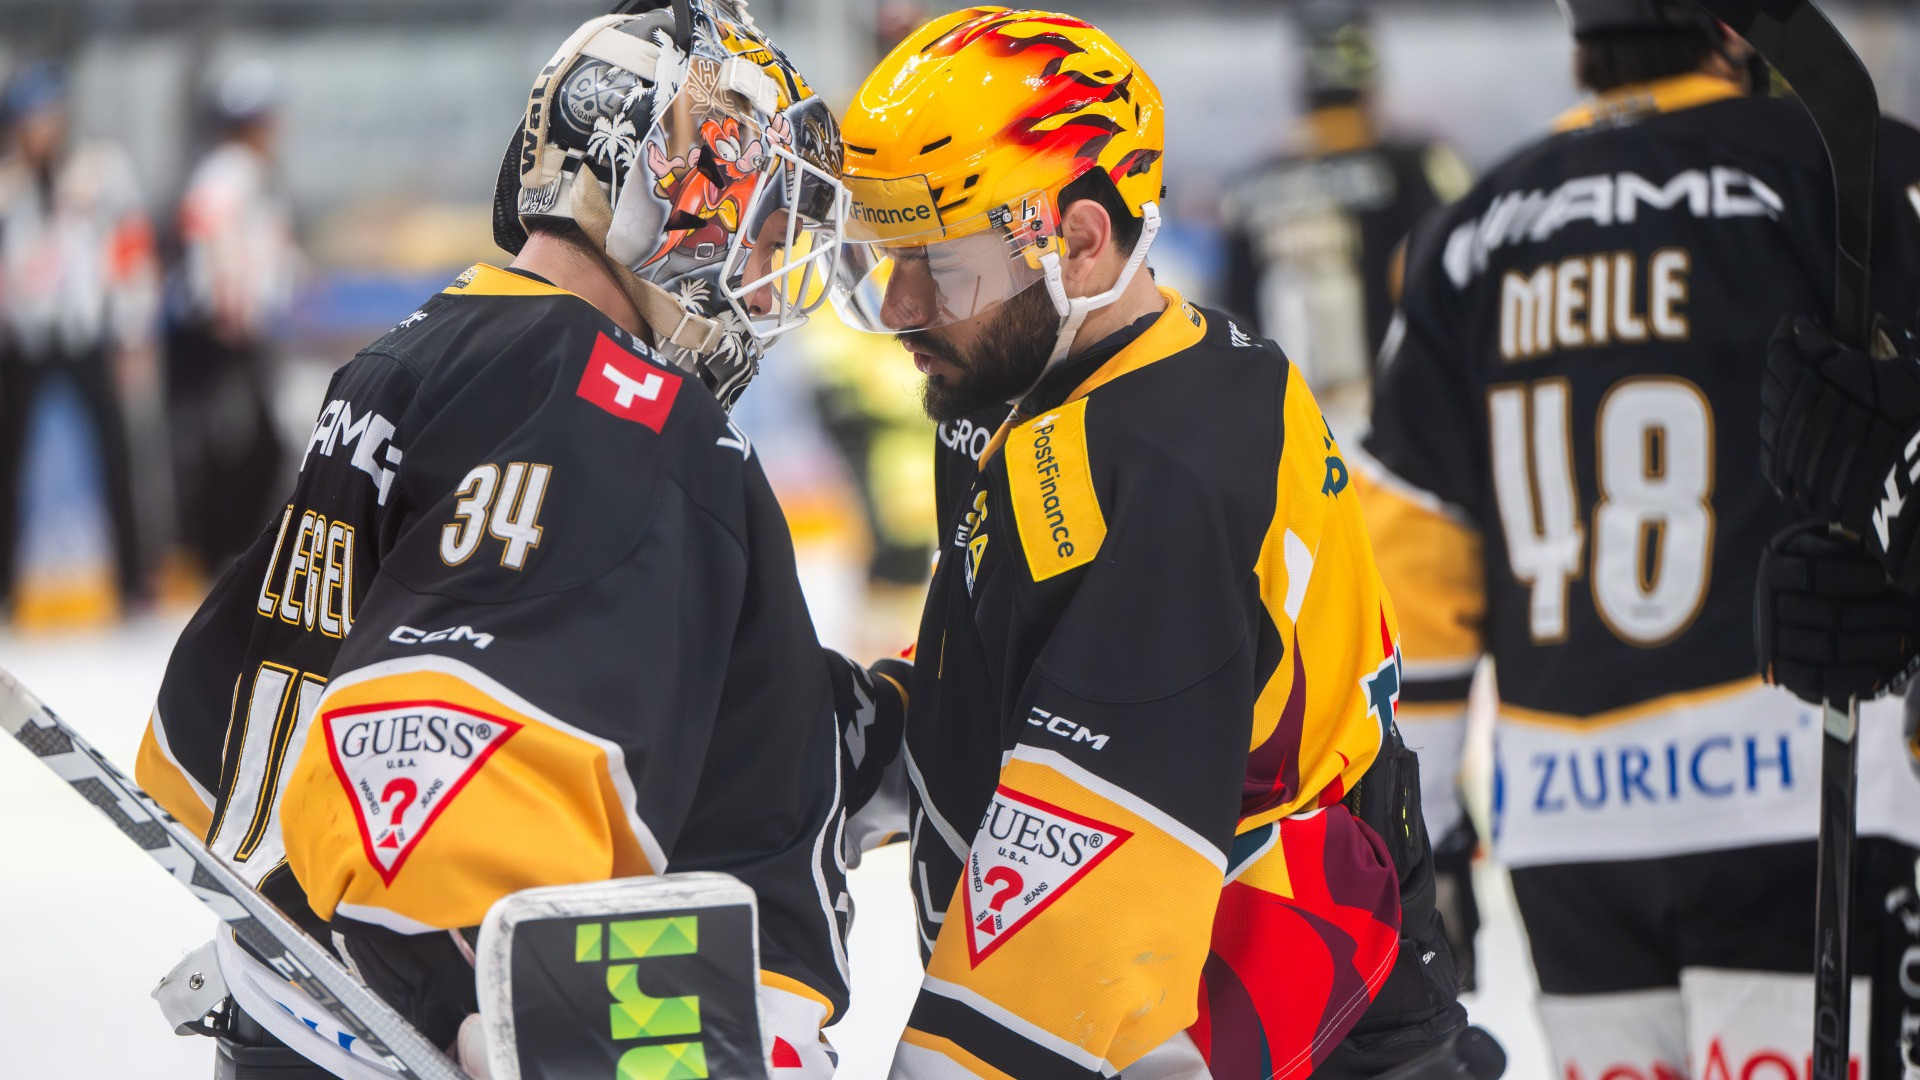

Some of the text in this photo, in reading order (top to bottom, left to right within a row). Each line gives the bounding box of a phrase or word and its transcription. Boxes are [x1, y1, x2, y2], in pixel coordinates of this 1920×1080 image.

[569, 102, 601, 127] LUGAN
[1501, 248, 1690, 360] MEILE
[1033, 423, 1076, 559] PostFinance
[1487, 373, 1717, 648] 48
[440, 462, 552, 571] 34
[388, 625, 495, 649] CCM
[420, 777, 444, 808] JEANS
[1531, 734, 1794, 812] ZURICH
[359, 777, 381, 816] WASHED
[971, 851, 983, 893] WASHED
[1022, 881, 1049, 906] JEANS
